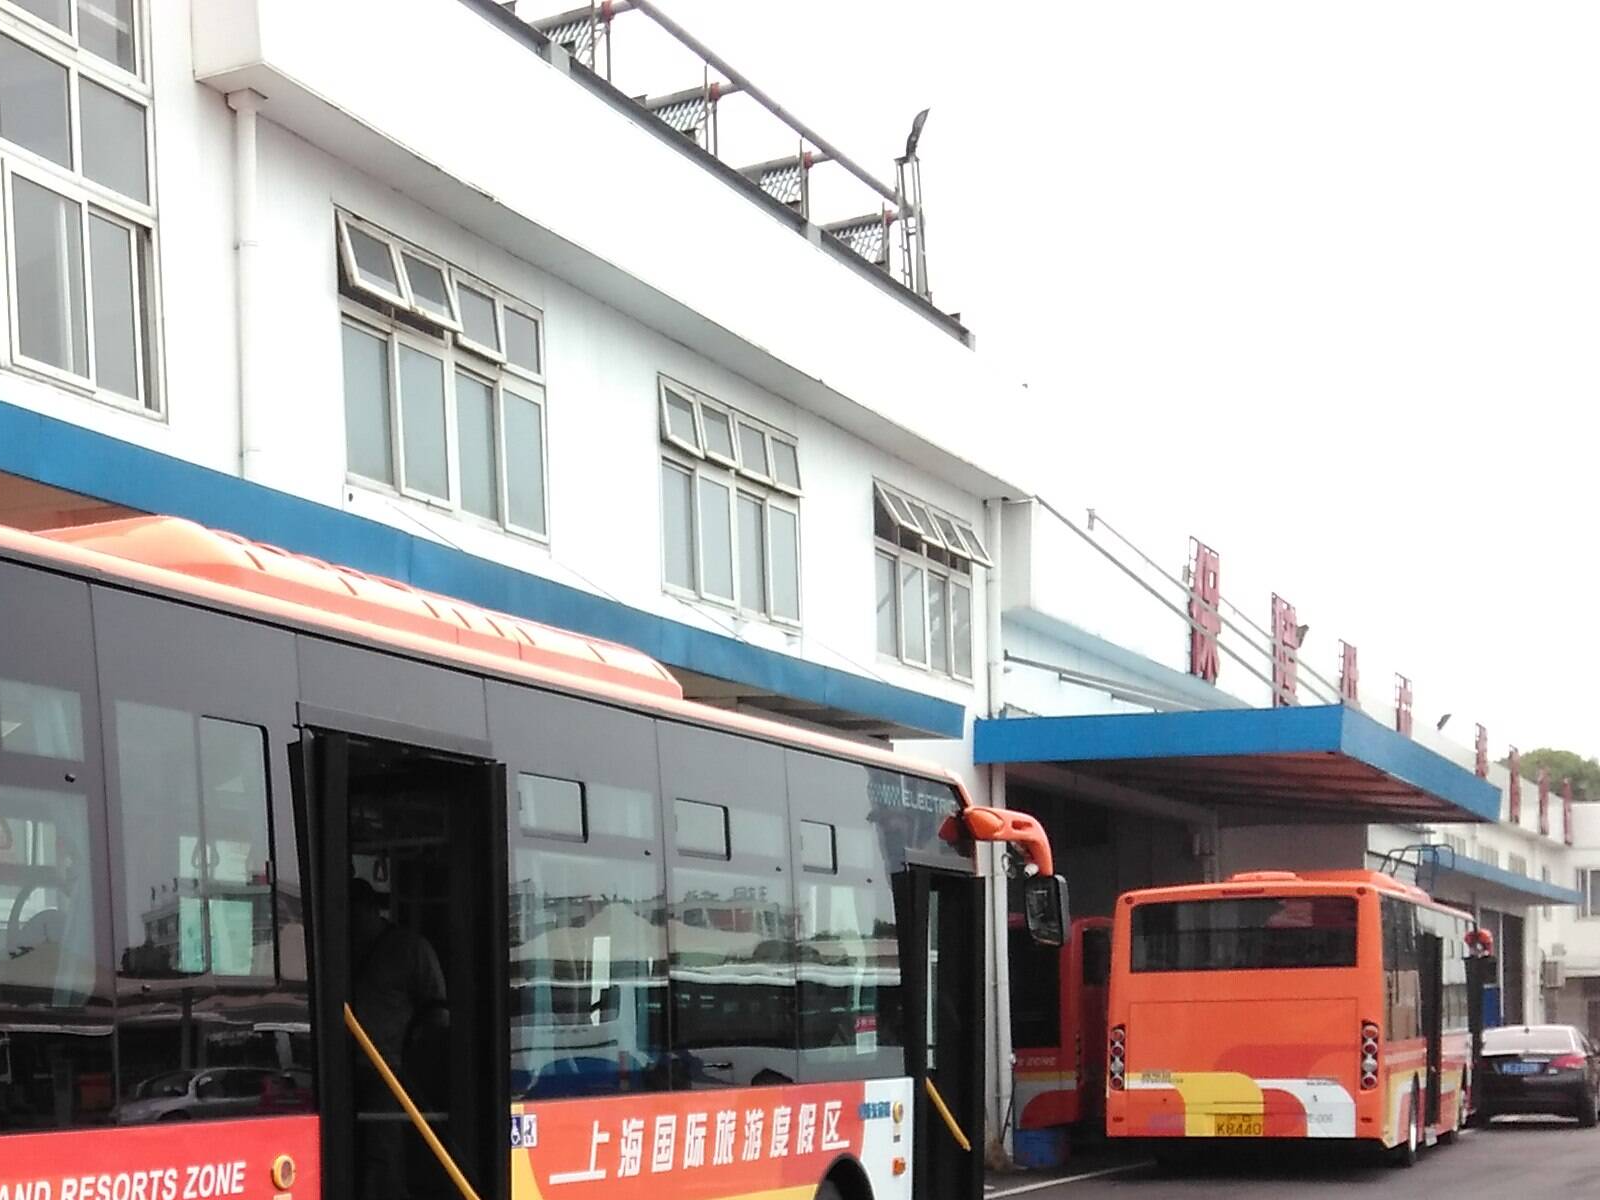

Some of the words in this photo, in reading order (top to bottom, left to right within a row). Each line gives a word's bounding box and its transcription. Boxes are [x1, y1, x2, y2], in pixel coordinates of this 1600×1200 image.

[549, 1100, 850, 1185] 上海国际旅游度假区
[183, 1162, 246, 1200] ZONE
